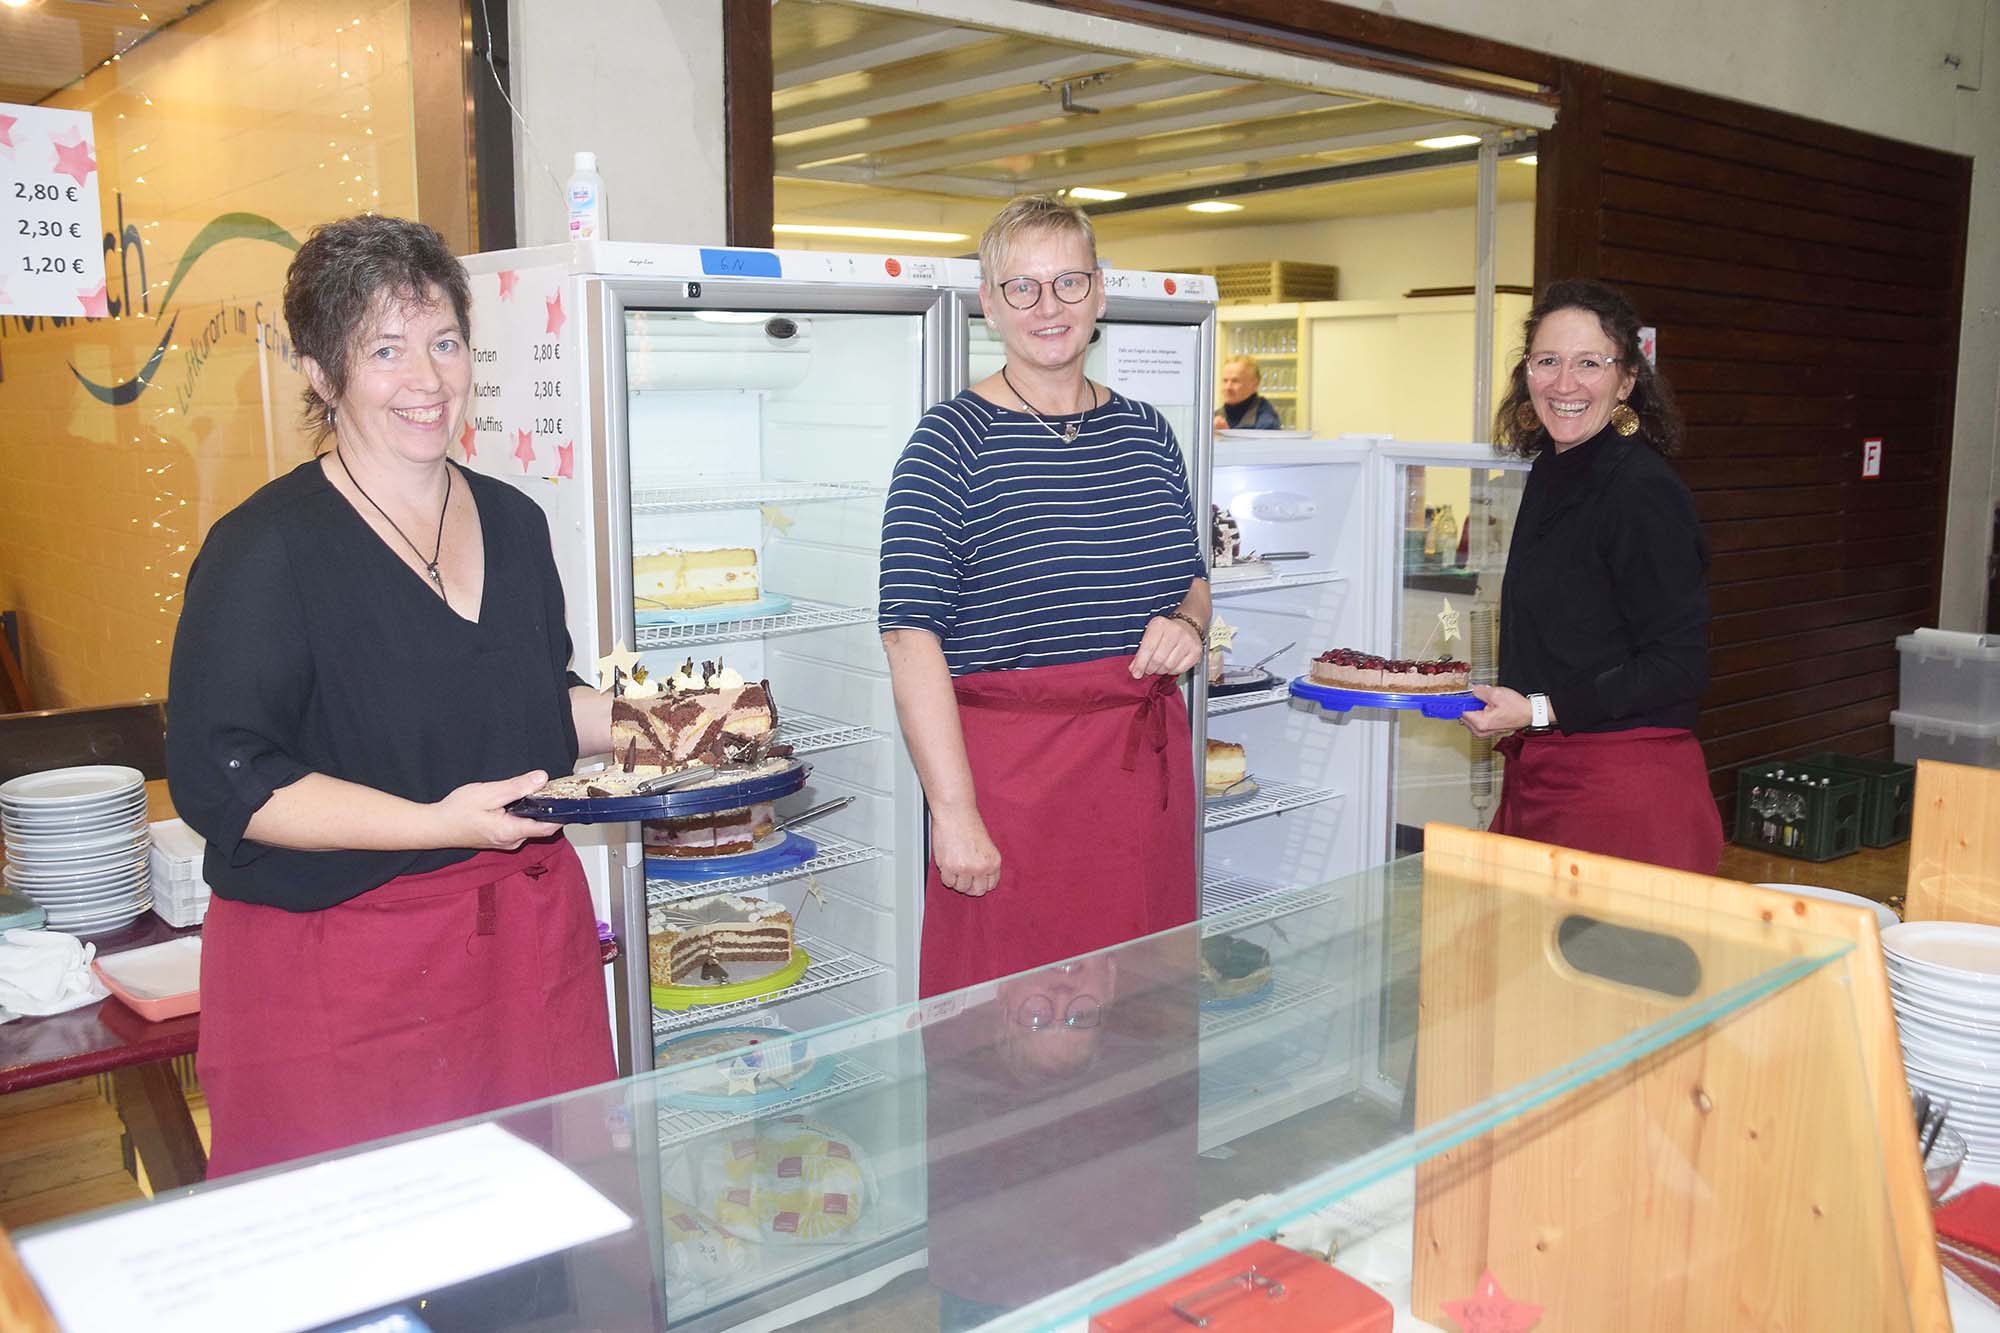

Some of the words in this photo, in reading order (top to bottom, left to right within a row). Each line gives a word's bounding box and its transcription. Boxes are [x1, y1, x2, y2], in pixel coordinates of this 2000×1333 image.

[14, 181, 60, 202] 2,80
[65, 186, 79, 202] €
[17, 218, 63, 239] 2,30
[68, 222, 82, 238] €
[22, 255, 67, 275] 1,20
[71, 258, 85, 274] €
[472, 348, 497, 362] Torten
[533, 343, 553, 363] 2,80
[554, 343, 561, 360] €
[473, 382, 501, 397] Kuchen
[534, 381, 554, 400] 2,30
[555, 380, 562, 397] €
[474, 416, 503, 432] Muffins
[535, 418, 555, 436] 1,20
[556, 418, 564, 434] €
[1867, 445, 1878, 472] F
